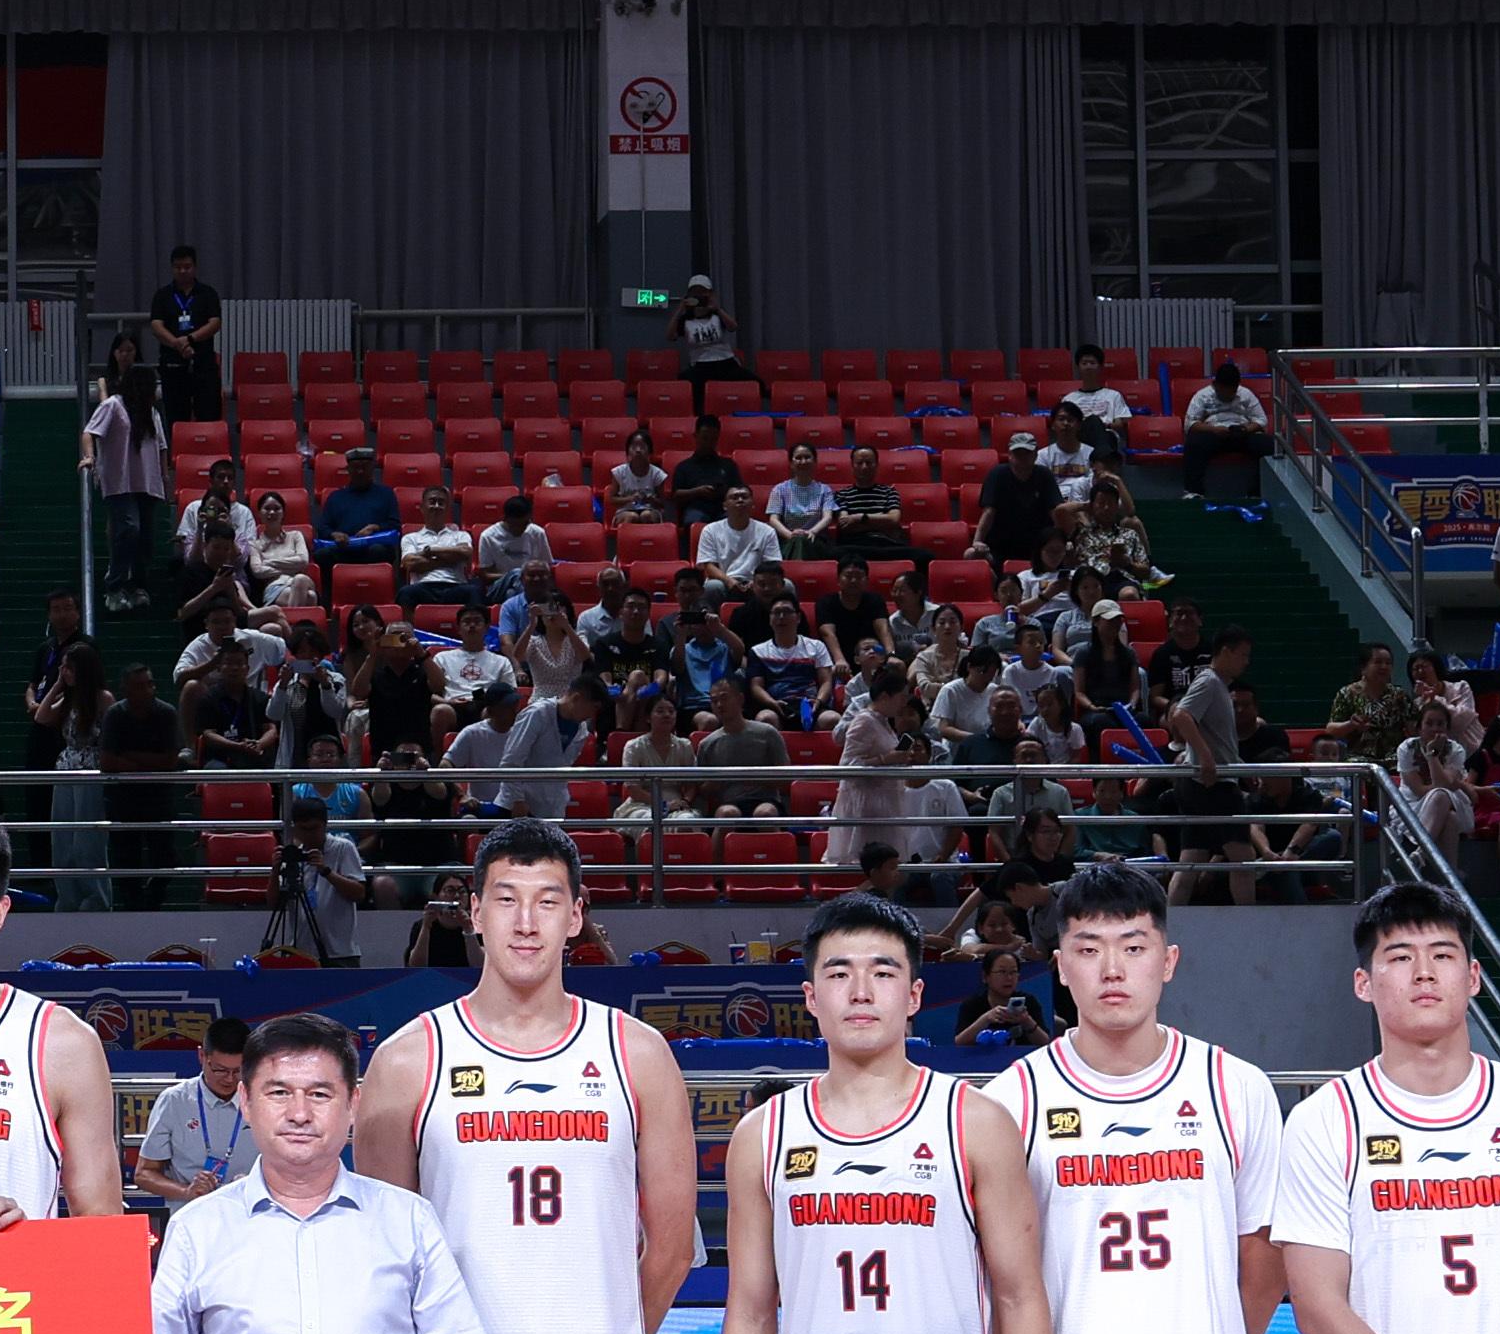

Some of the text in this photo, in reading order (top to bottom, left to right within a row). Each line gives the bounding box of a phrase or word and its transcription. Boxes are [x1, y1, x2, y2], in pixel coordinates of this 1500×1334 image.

[618, 137, 681, 152] 禁止吸烟
[584, 1089, 602, 1098] CGB
[457, 1110, 609, 1143] GUANGDONG
[1179, 1129, 1198, 1137] CGB
[914, 1171, 933, 1180] CGB
[1057, 1148, 1204, 1187] GUANGDONG
[507, 1164, 562, 1225] 18
[791, 1192, 936, 1227] GUANGDONG
[1098, 1208, 1170, 1272] 25
[835, 1249, 890, 1312] 14
[1441, 1234, 1478, 1295] 5
